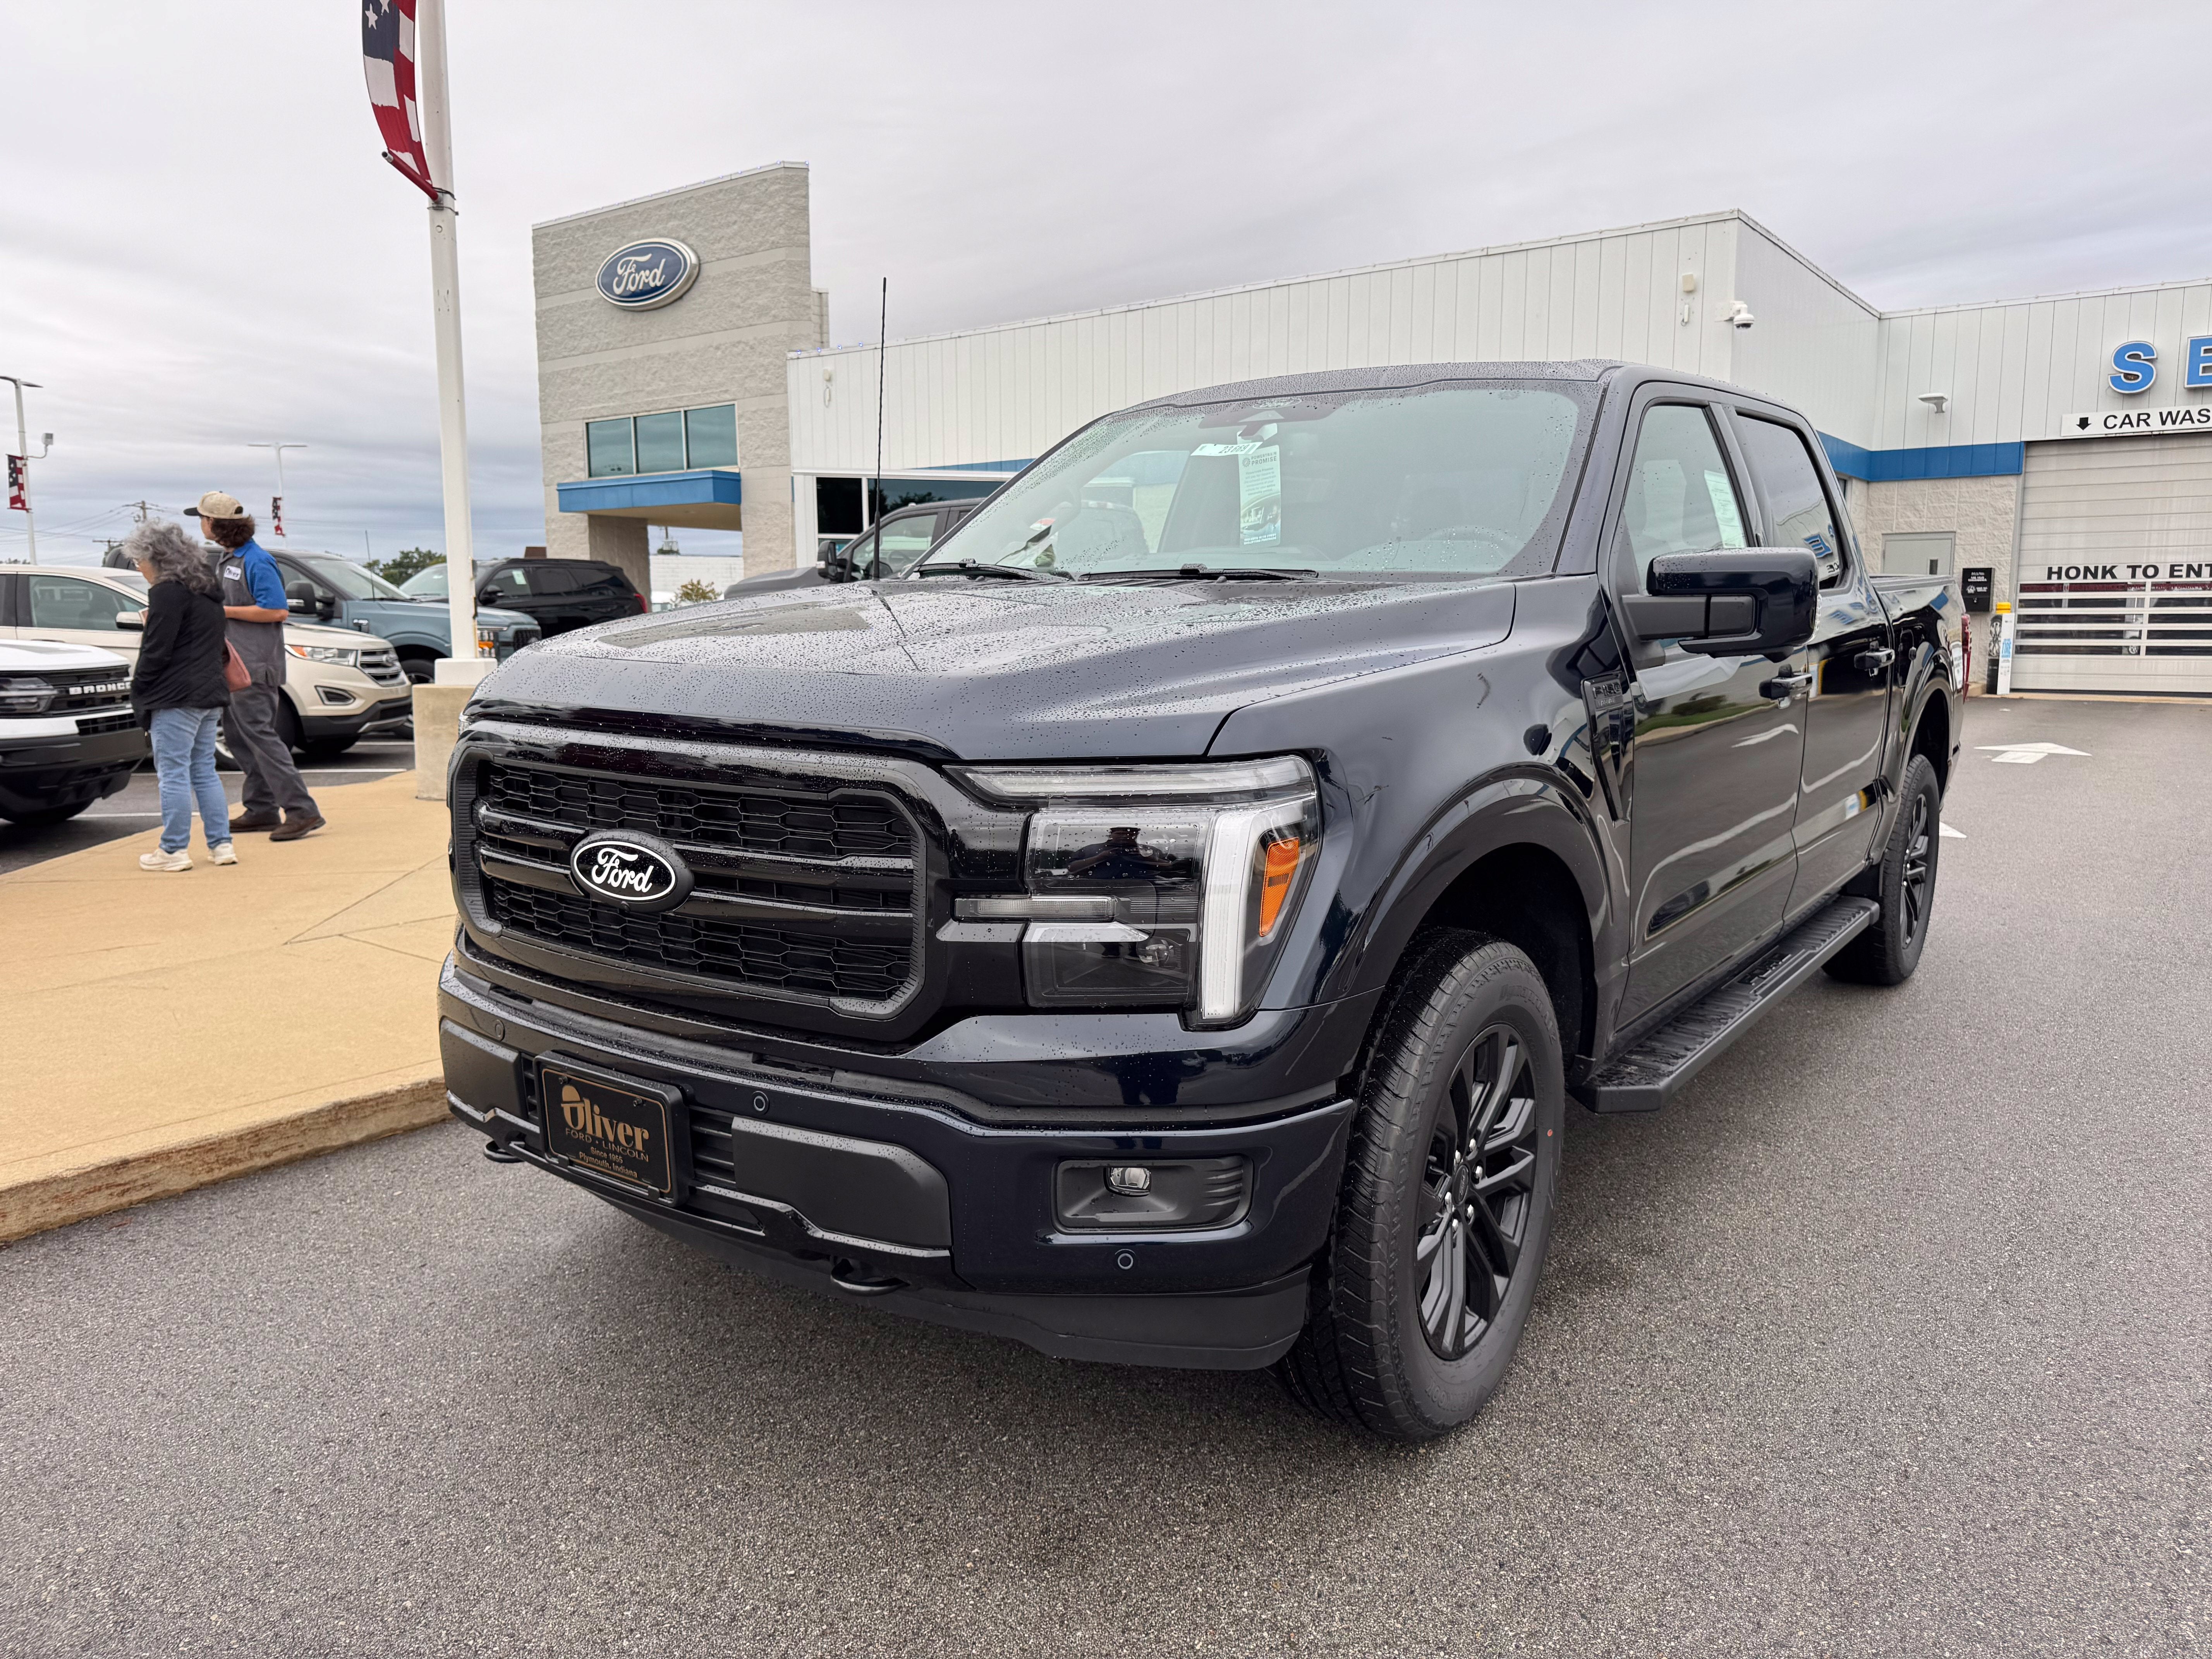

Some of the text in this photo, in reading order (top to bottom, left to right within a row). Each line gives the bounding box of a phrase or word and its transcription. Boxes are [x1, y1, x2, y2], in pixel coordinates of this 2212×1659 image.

[613, 253, 666, 295] Ford
[2103, 408, 2210, 429] CAR WAS
[1218, 444, 1250, 453] 23669
[1251, 452, 1277, 460] POWERTRAIN
[1251, 456, 1277, 465] PROMISE
[2047, 565, 2118, 580] HONK
[2126, 565, 2159, 579] TO
[592, 848, 654, 893] Ford
[561, 1085, 649, 1152] Oliver
[565, 1127, 649, 1162] FORD LINCOLN
[591, 1147, 608, 1159] Since
[579, 1152, 638, 1178] Plymouth, Indiana
